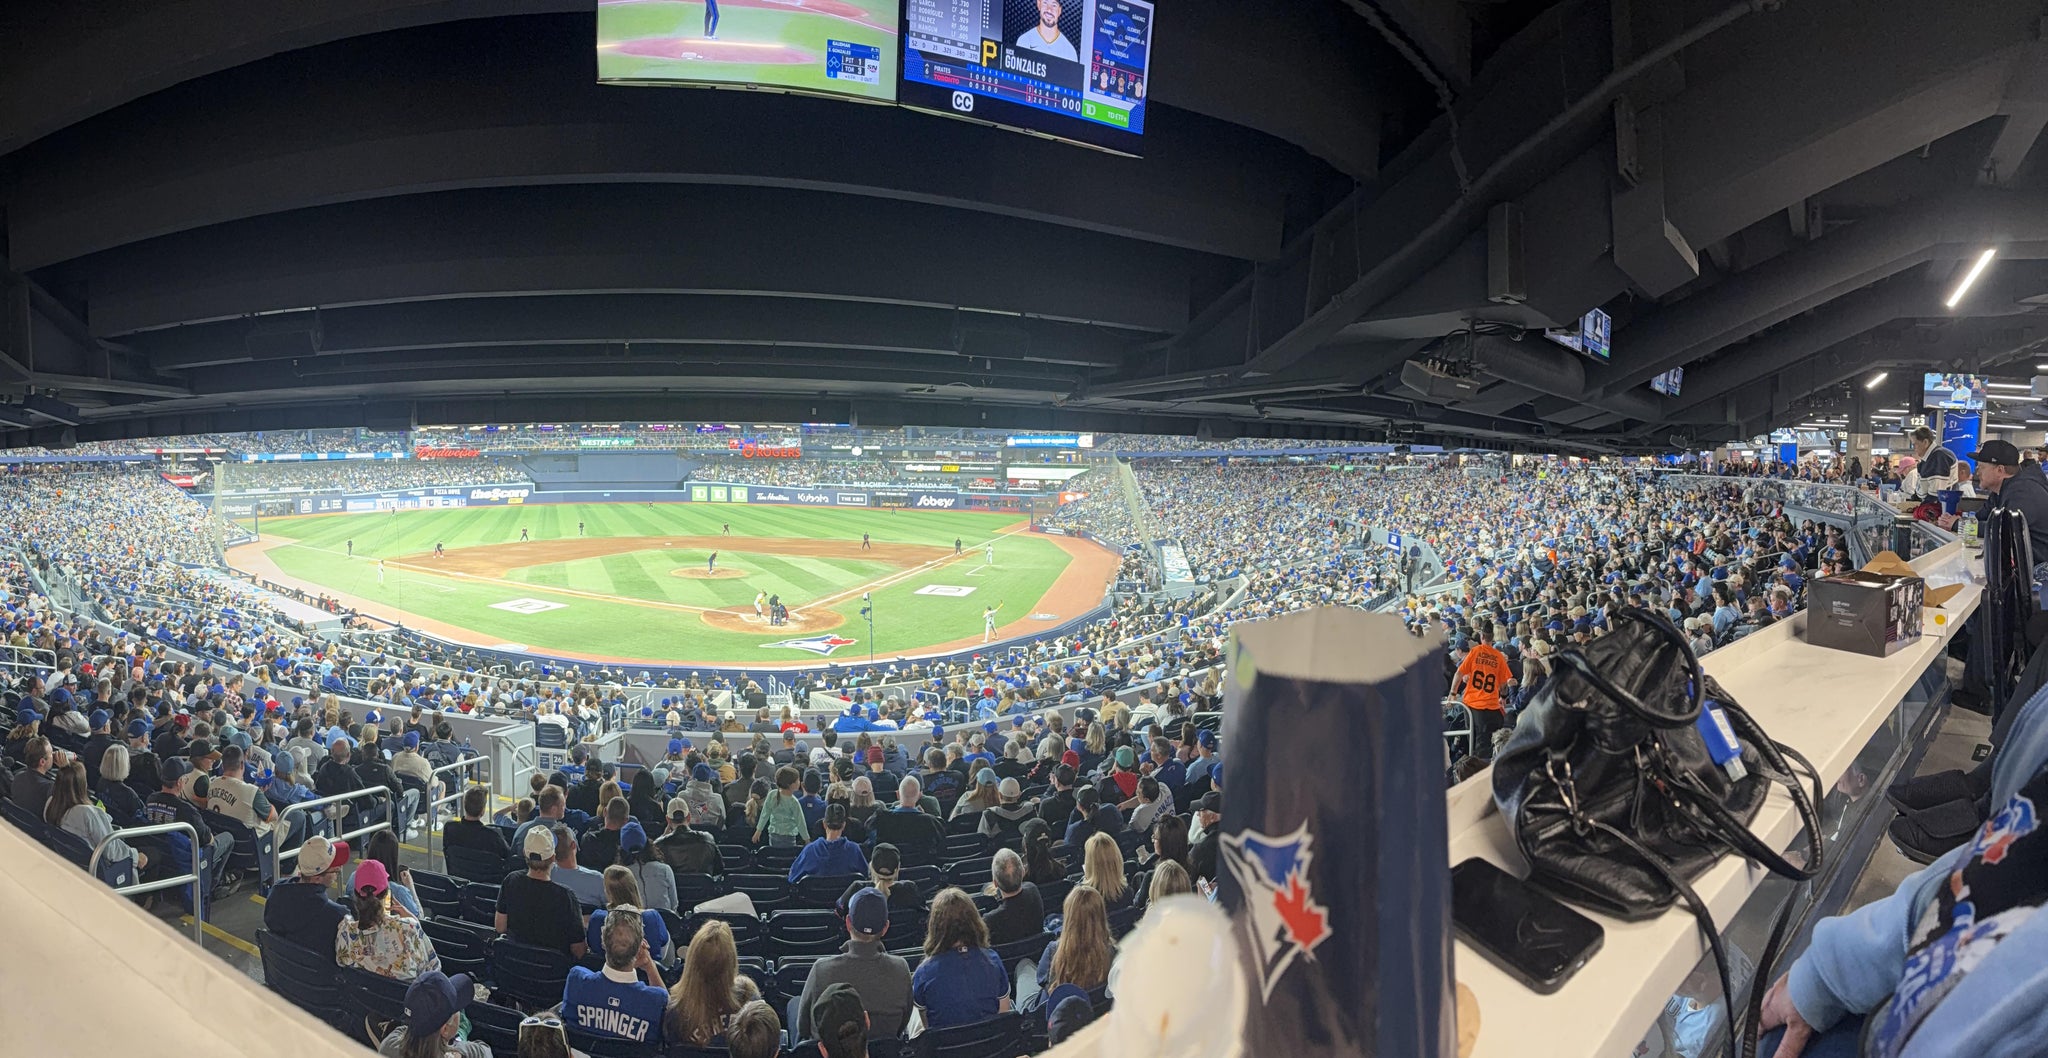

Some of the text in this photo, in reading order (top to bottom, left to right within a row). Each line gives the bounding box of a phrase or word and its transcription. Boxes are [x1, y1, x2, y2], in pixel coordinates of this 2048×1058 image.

[982, 40, 997, 67] P
[934, 65, 951, 74] PIRATES
[1005, 55, 1047, 78] GONZALES
[934, 74, 959, 85] TORONTO
[955, 94, 971, 109] CC
[1062, 98, 1081, 111] 0 0 0
[1085, 103, 1096, 115] TD
[1910, 417, 1925, 426] 123
[414, 445, 480, 458] Budweiser
[756, 448, 801, 458] ROGERS
[470, 488, 529, 500] theScore
[798, 494, 829, 502] Kubota
[917, 495, 955, 508] Sobeys
[1472, 670, 1495, 693] 68
[577, 1004, 649, 1042] SPRINGER
